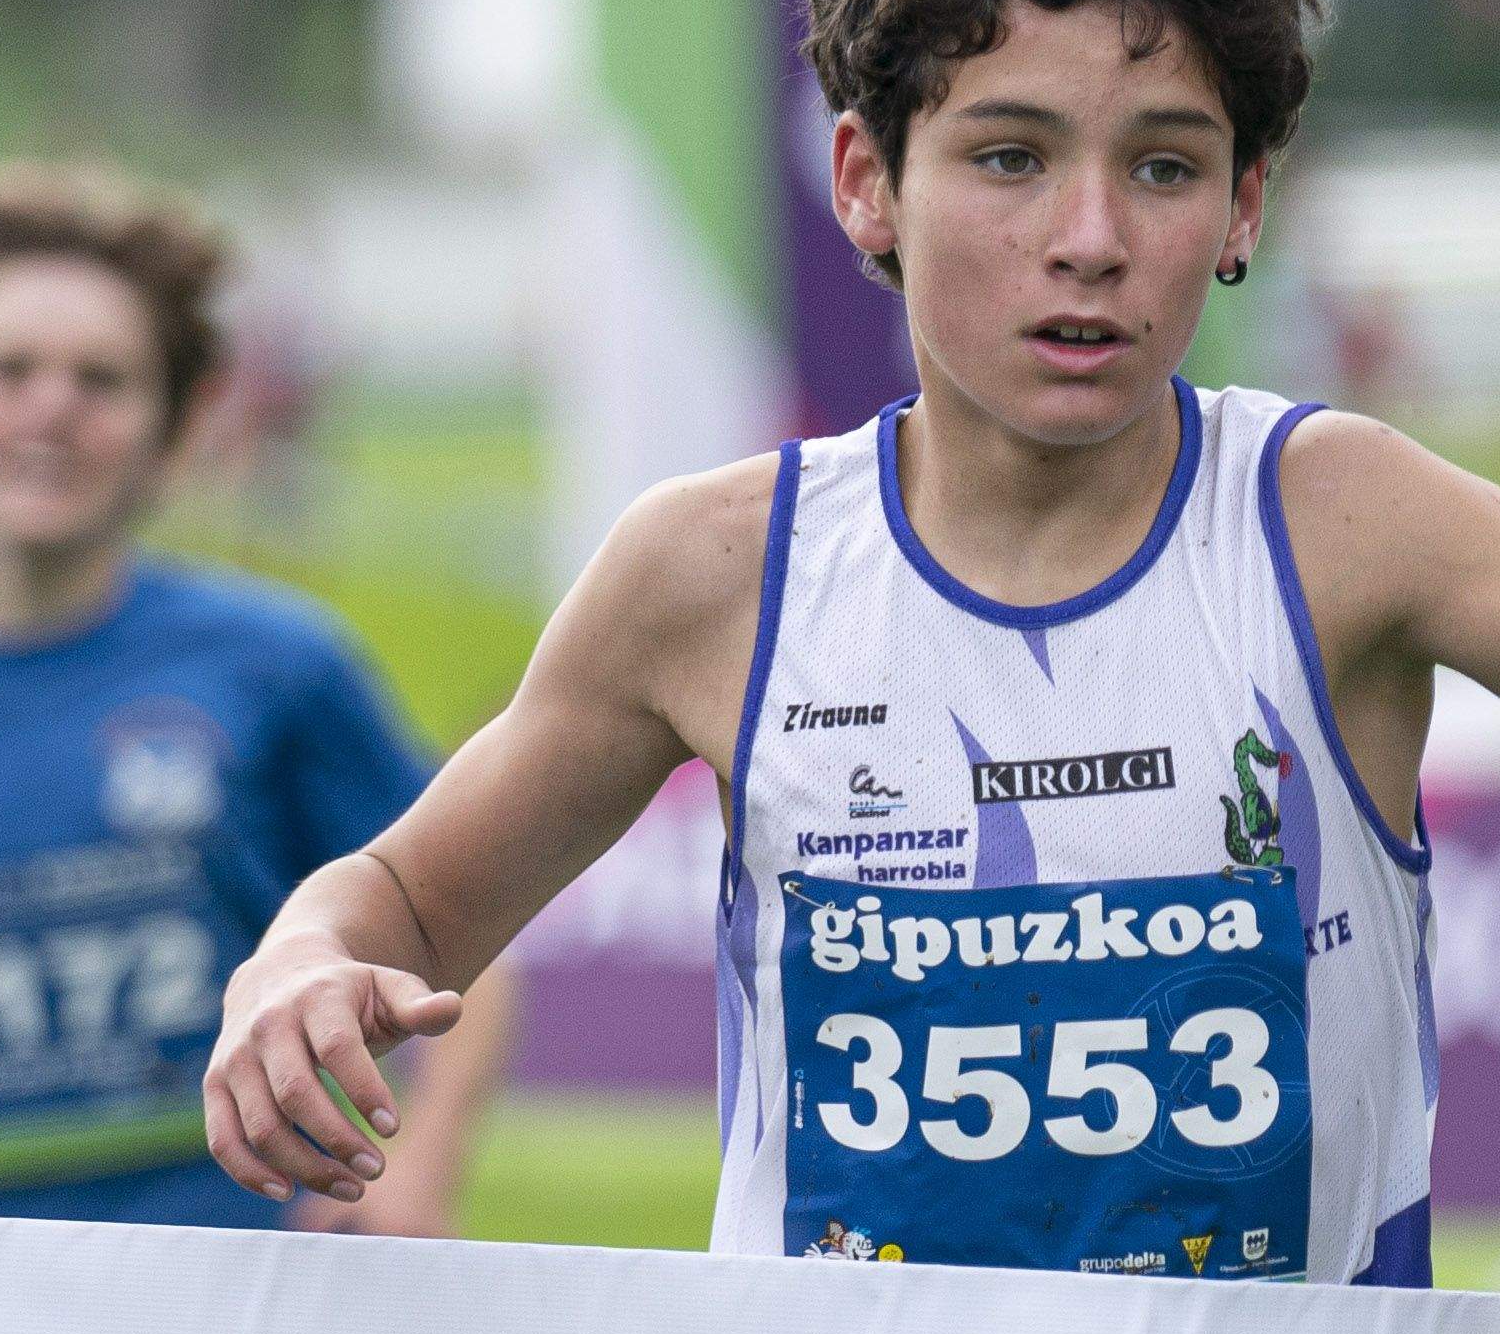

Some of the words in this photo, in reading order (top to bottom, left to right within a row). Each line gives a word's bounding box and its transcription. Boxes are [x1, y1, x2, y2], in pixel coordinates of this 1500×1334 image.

[783, 702, 888, 733] Zirauna
[978, 752, 1169, 800] KIROLGI
[797, 827, 969, 860] Kanpanzar
[857, 861, 967, 882] harrobia
[809, 893, 1263, 982] gipuzkoa
[816, 1007, 1280, 1162] 3553
